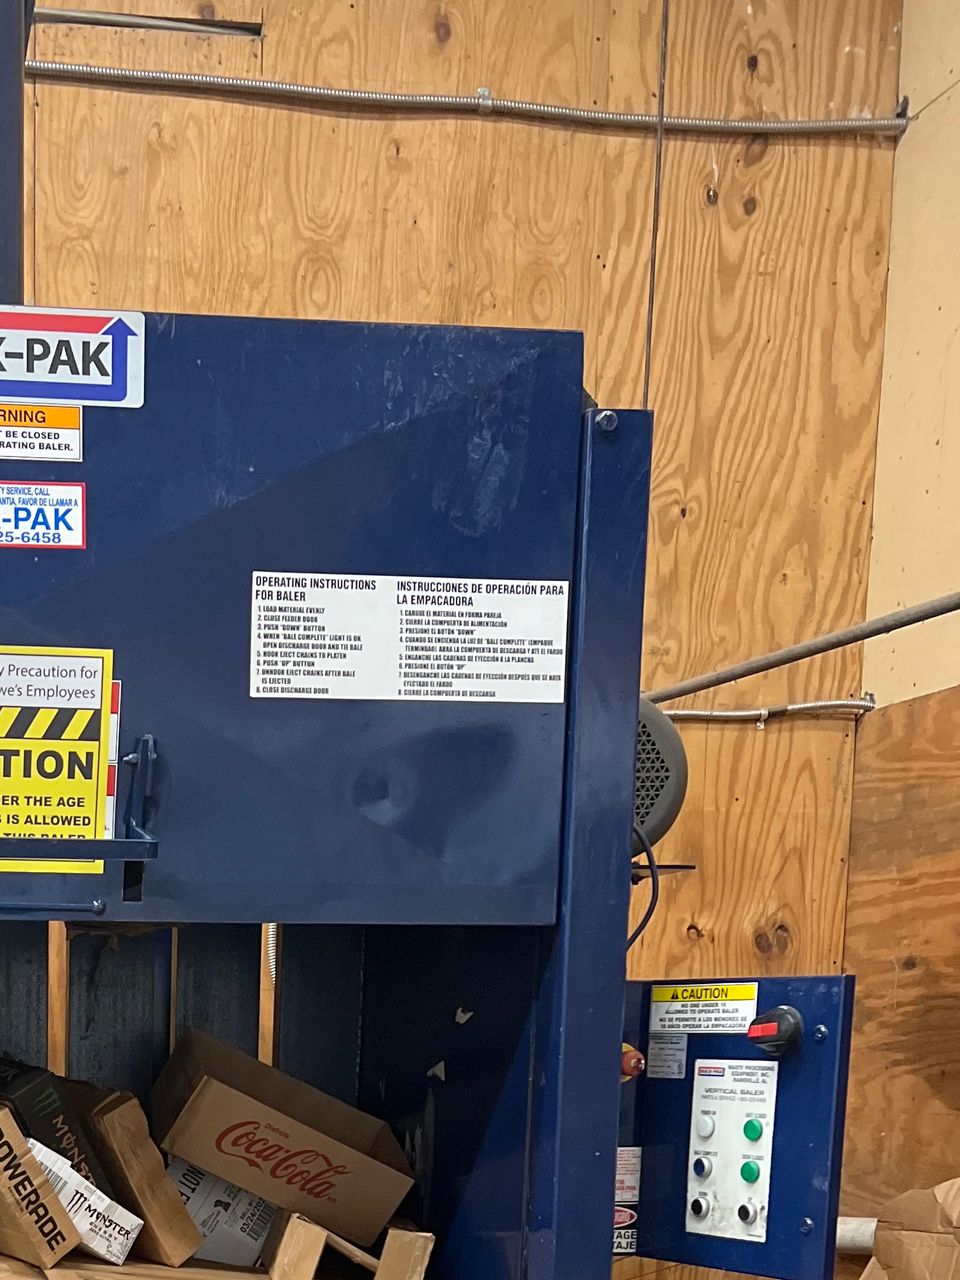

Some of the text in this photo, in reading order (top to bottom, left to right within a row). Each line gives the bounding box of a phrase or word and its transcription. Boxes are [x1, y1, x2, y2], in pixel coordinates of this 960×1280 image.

[5, 430, 18, 439] BE
[21, 431, 60, 440] CLOSED
[39, 441, 73, 451] BALER.
[6, 486, 33, 497] SERVICE,
[35, 487, 50, 496] CALL
[256, 576, 376, 590] OPERATING INSTRUCTIONS
[397, 581, 564, 595] INSTRUCCIONES DE OPERACIÓN PARA
[256, 590, 306, 601] FOR BALER
[397, 595, 473, 606] LA EMPACADORA
[8, 665, 76, 679] Precaution
[80, 667, 98, 679] for
[27, 685, 95, 701] Employees
[24, 796, 52, 807] THE
[56, 797, 85, 807] AGE
[7, 814, 19, 825] IS
[24, 815, 91, 826] ALLOWED
[681, 988, 728, 999] CAUTION
[85, 1203, 131, 1241] MONSTER
